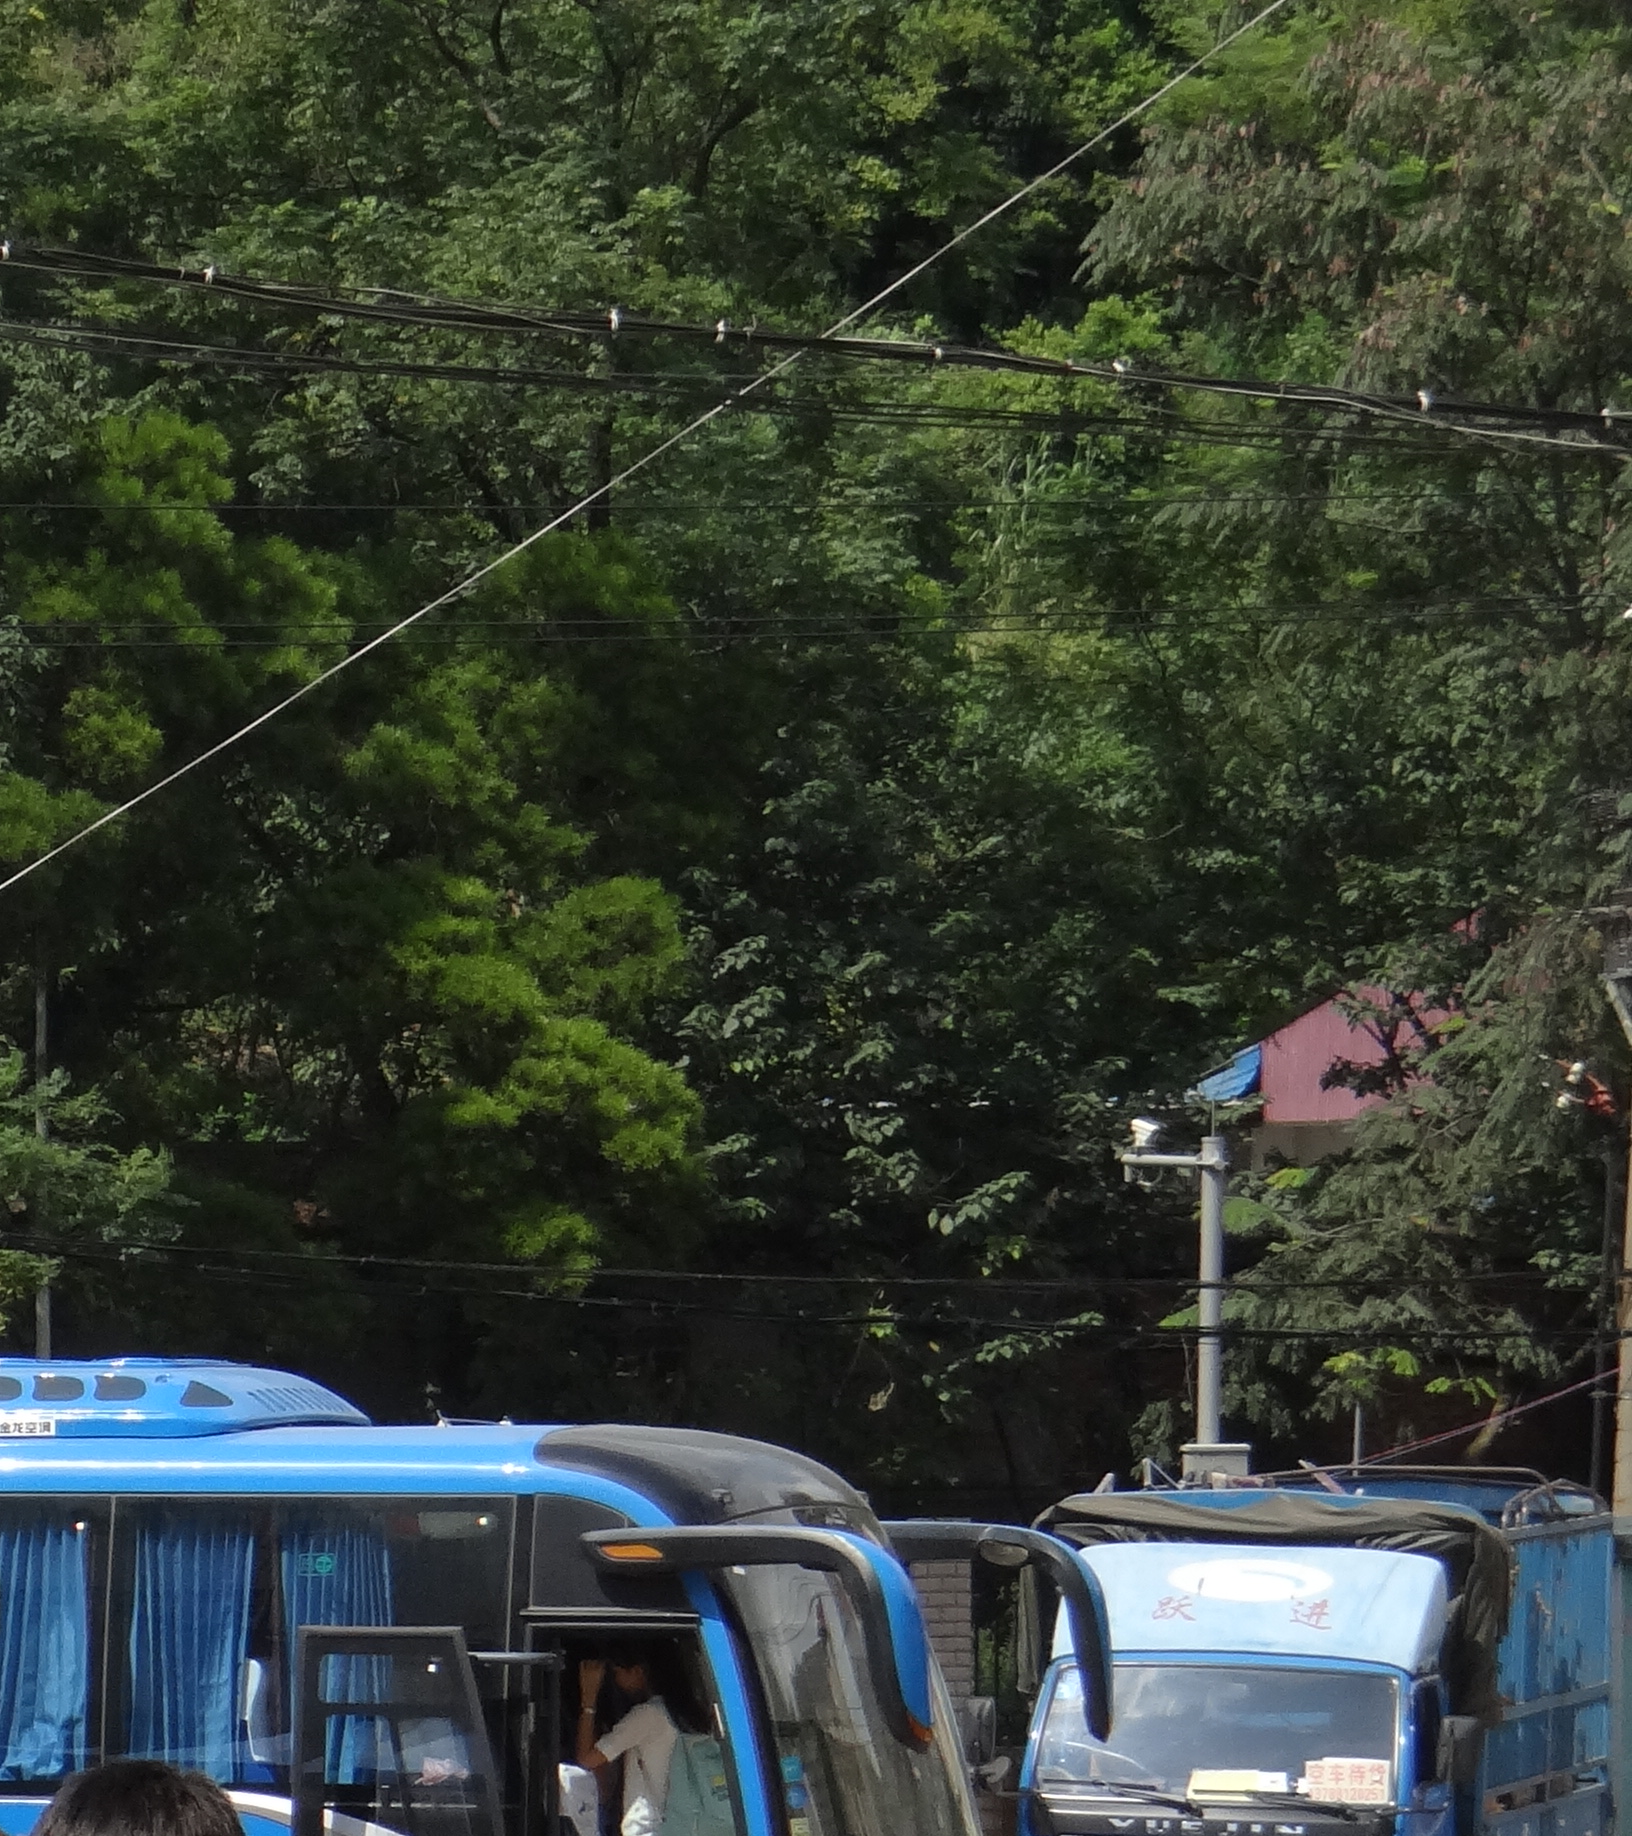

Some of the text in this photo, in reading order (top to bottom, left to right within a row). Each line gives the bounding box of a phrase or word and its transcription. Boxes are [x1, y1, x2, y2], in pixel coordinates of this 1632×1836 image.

[0, 1420, 52, 1434] 金龙空调
[1308, 1763, 1387, 1787] 空车待货
